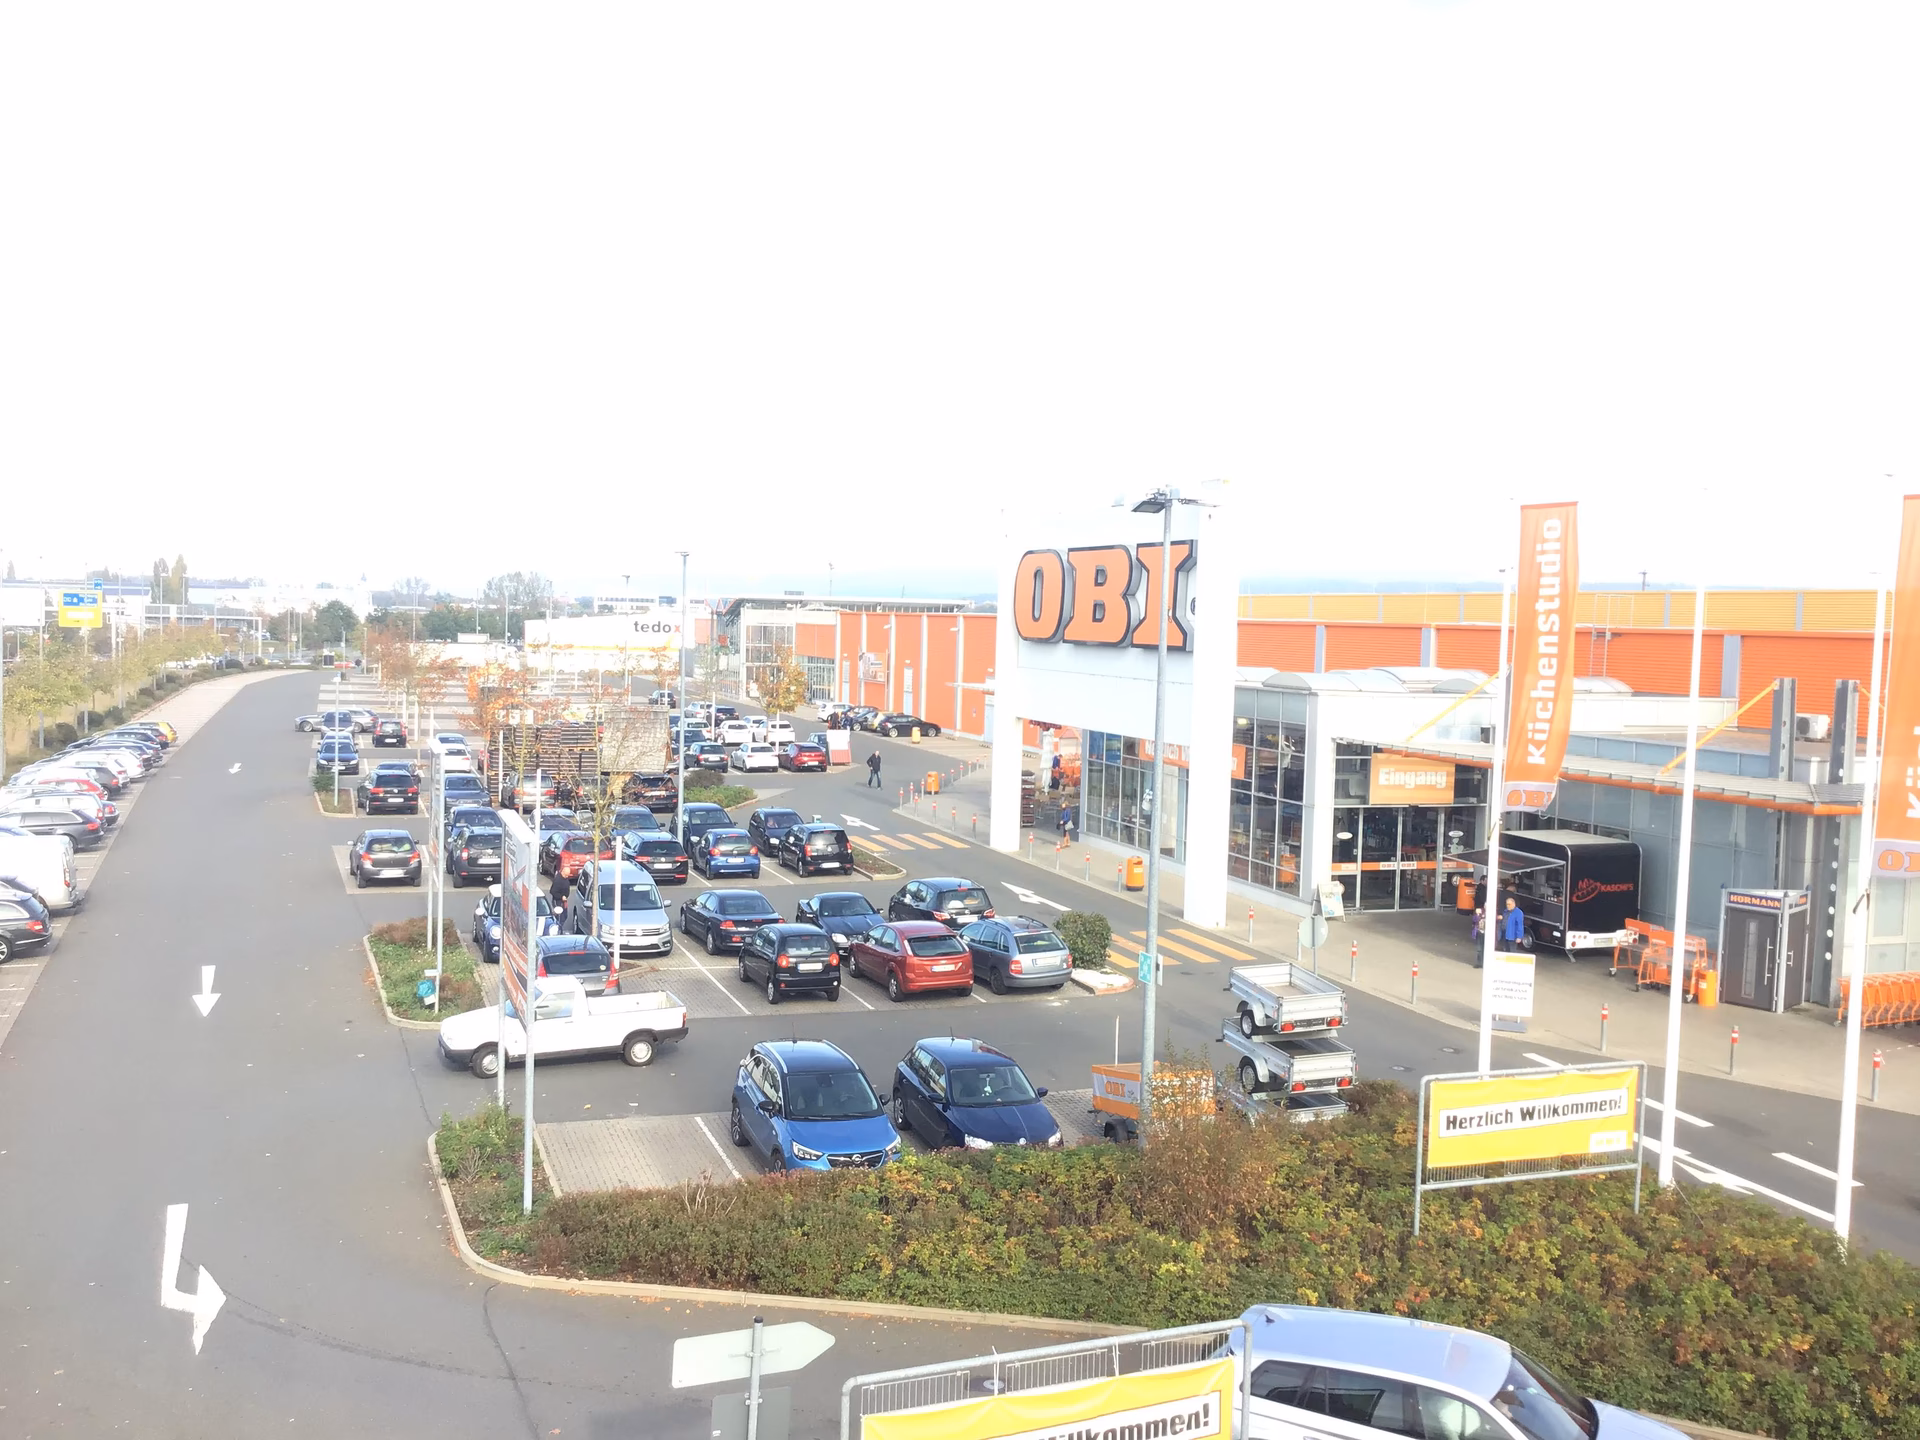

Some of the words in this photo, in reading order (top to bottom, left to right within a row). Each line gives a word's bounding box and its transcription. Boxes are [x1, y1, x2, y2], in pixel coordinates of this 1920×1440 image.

[1014, 540, 1194, 651] OBI
[633, 621, 682, 633] tedox
[1527, 518, 1562, 764] Küchenstudio
[1378, 767, 1447, 789] Eingang
[1105, 1080, 1126, 1098] OBI
[1446, 1109, 1514, 1131] Herzlich
[1520, 1095, 1622, 1122] Willkommen!
